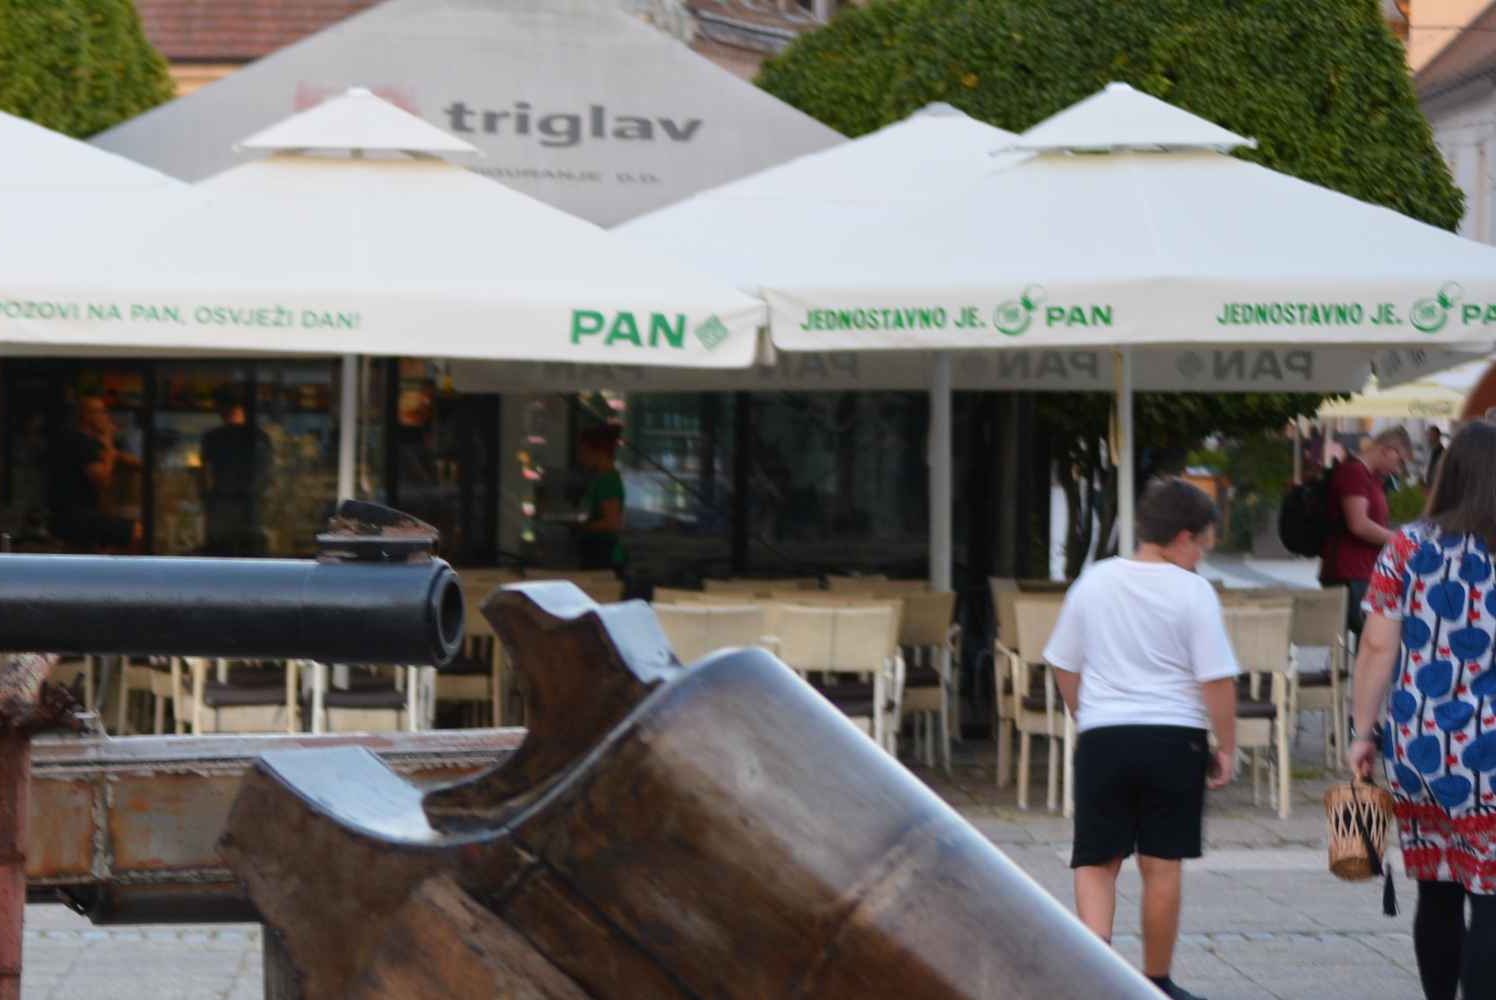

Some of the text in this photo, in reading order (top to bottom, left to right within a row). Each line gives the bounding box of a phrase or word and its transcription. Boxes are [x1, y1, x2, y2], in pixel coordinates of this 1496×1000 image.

[444, 101, 702, 148] triglav
[88, 303, 121, 321] NA
[194, 305, 294, 327] OSVJEŽI
[801, 305, 1113, 331] JEDNOSTAVNO JE. PAN
[1217, 303, 1364, 325] JEDNOSTAVNO
[1371, 304, 1403, 325] JE.
[570, 309, 686, 349] PAN
